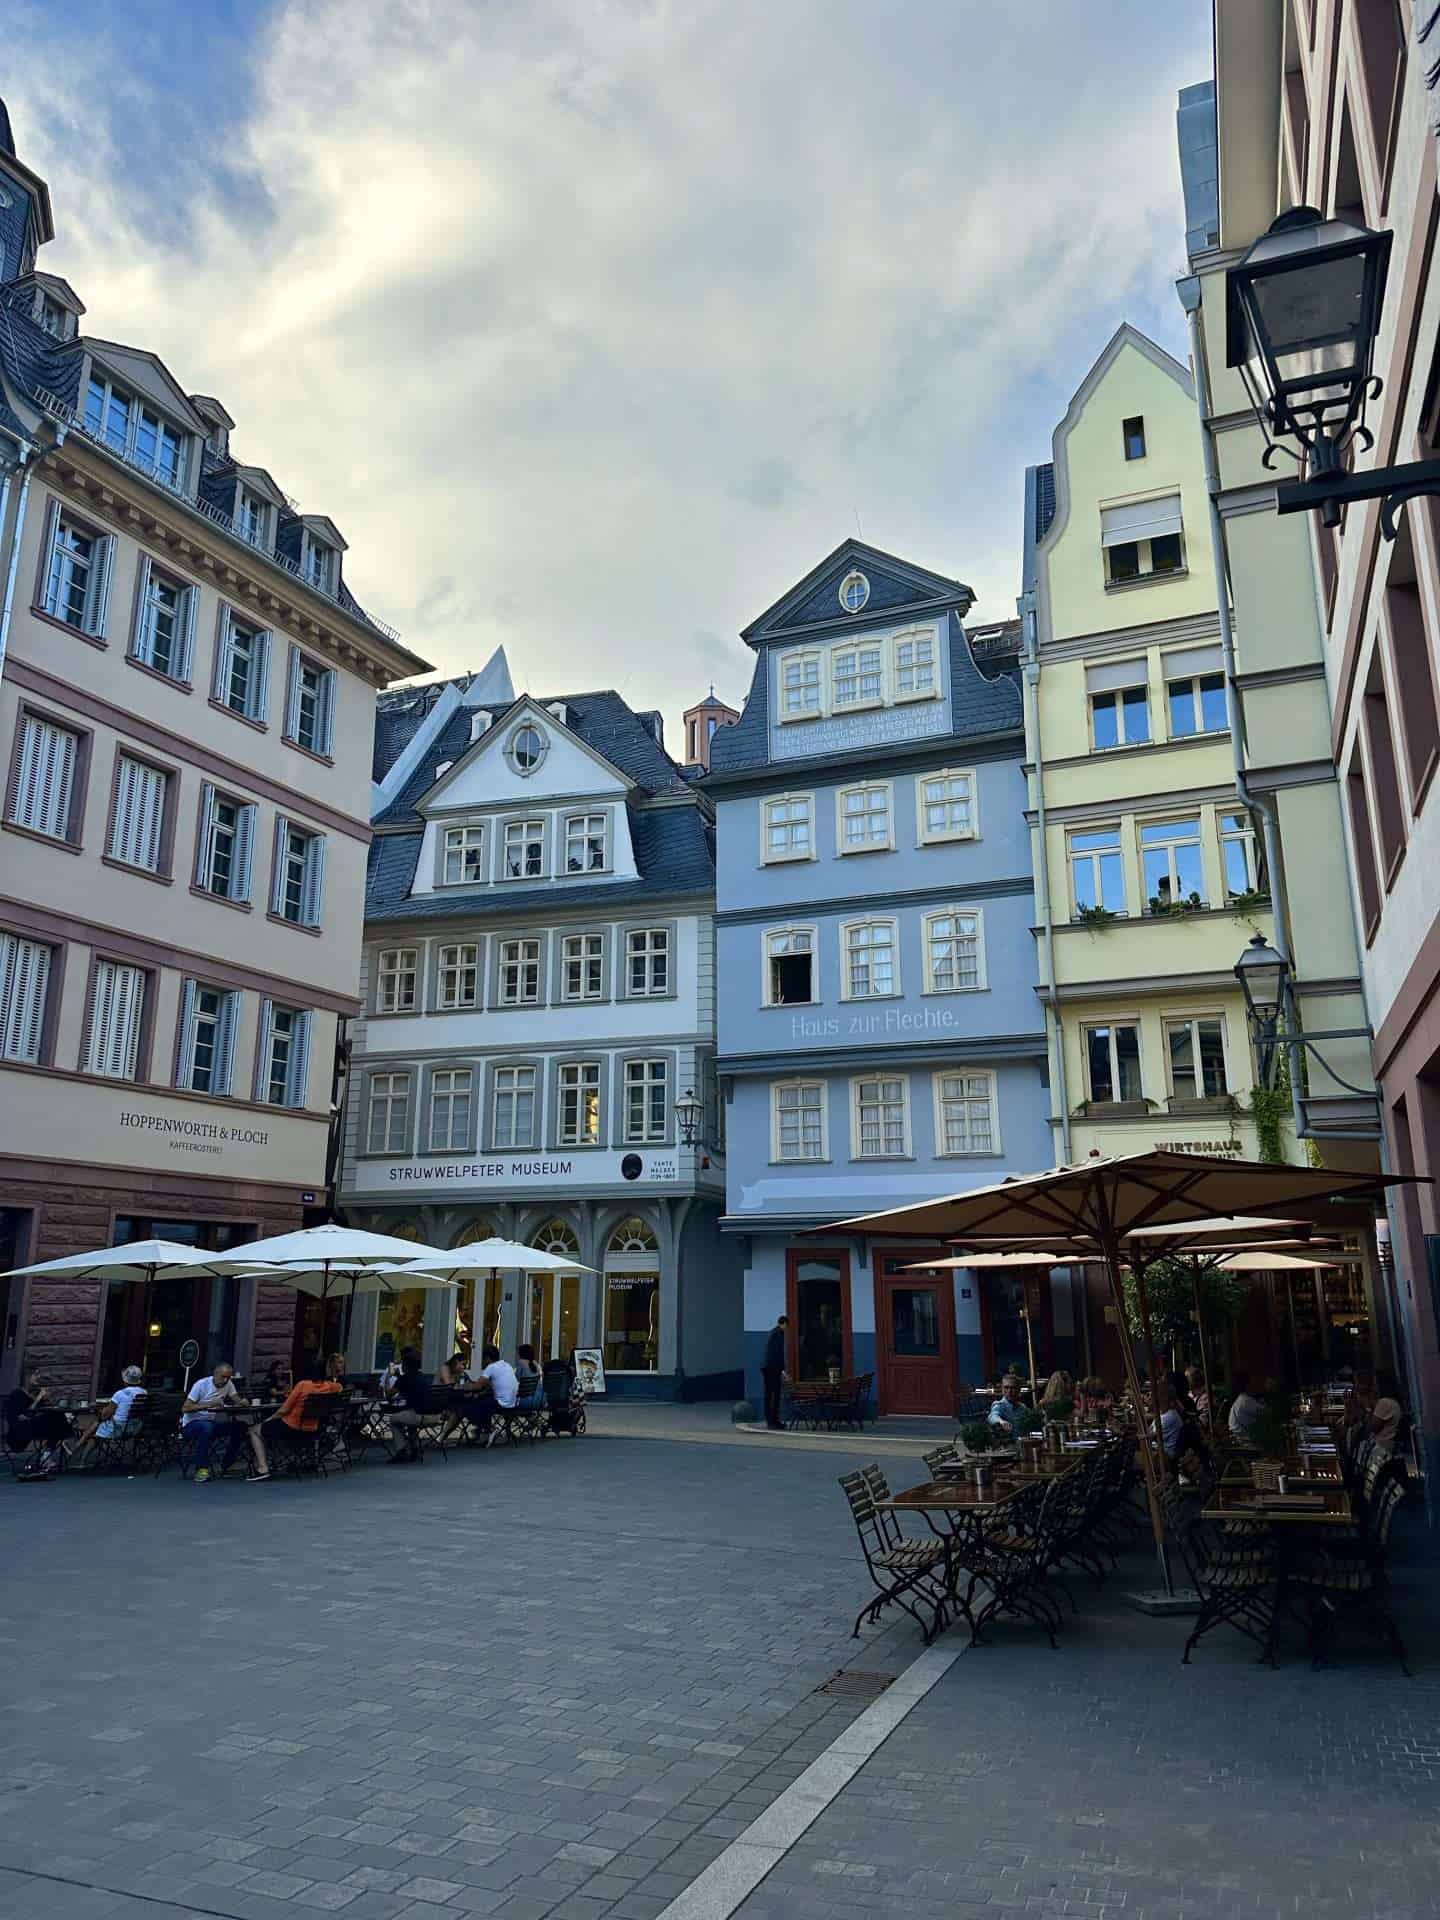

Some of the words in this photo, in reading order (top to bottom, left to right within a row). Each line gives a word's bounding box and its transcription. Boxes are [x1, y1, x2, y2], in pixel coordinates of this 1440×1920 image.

[791, 1015, 840, 1040] Haus
[848, 1014, 880, 1034] zur
[120, 1111, 218, 1139] HOPPENWORTH
[219, 1127, 229, 1139] &
[231, 1128, 269, 1145] PLOCH
[1154, 1141, 1243, 1153] WIRTSHAUS
[389, 1163, 505, 1181] STRUWWELPETER
[511, 1161, 572, 1176] MUSEUM
